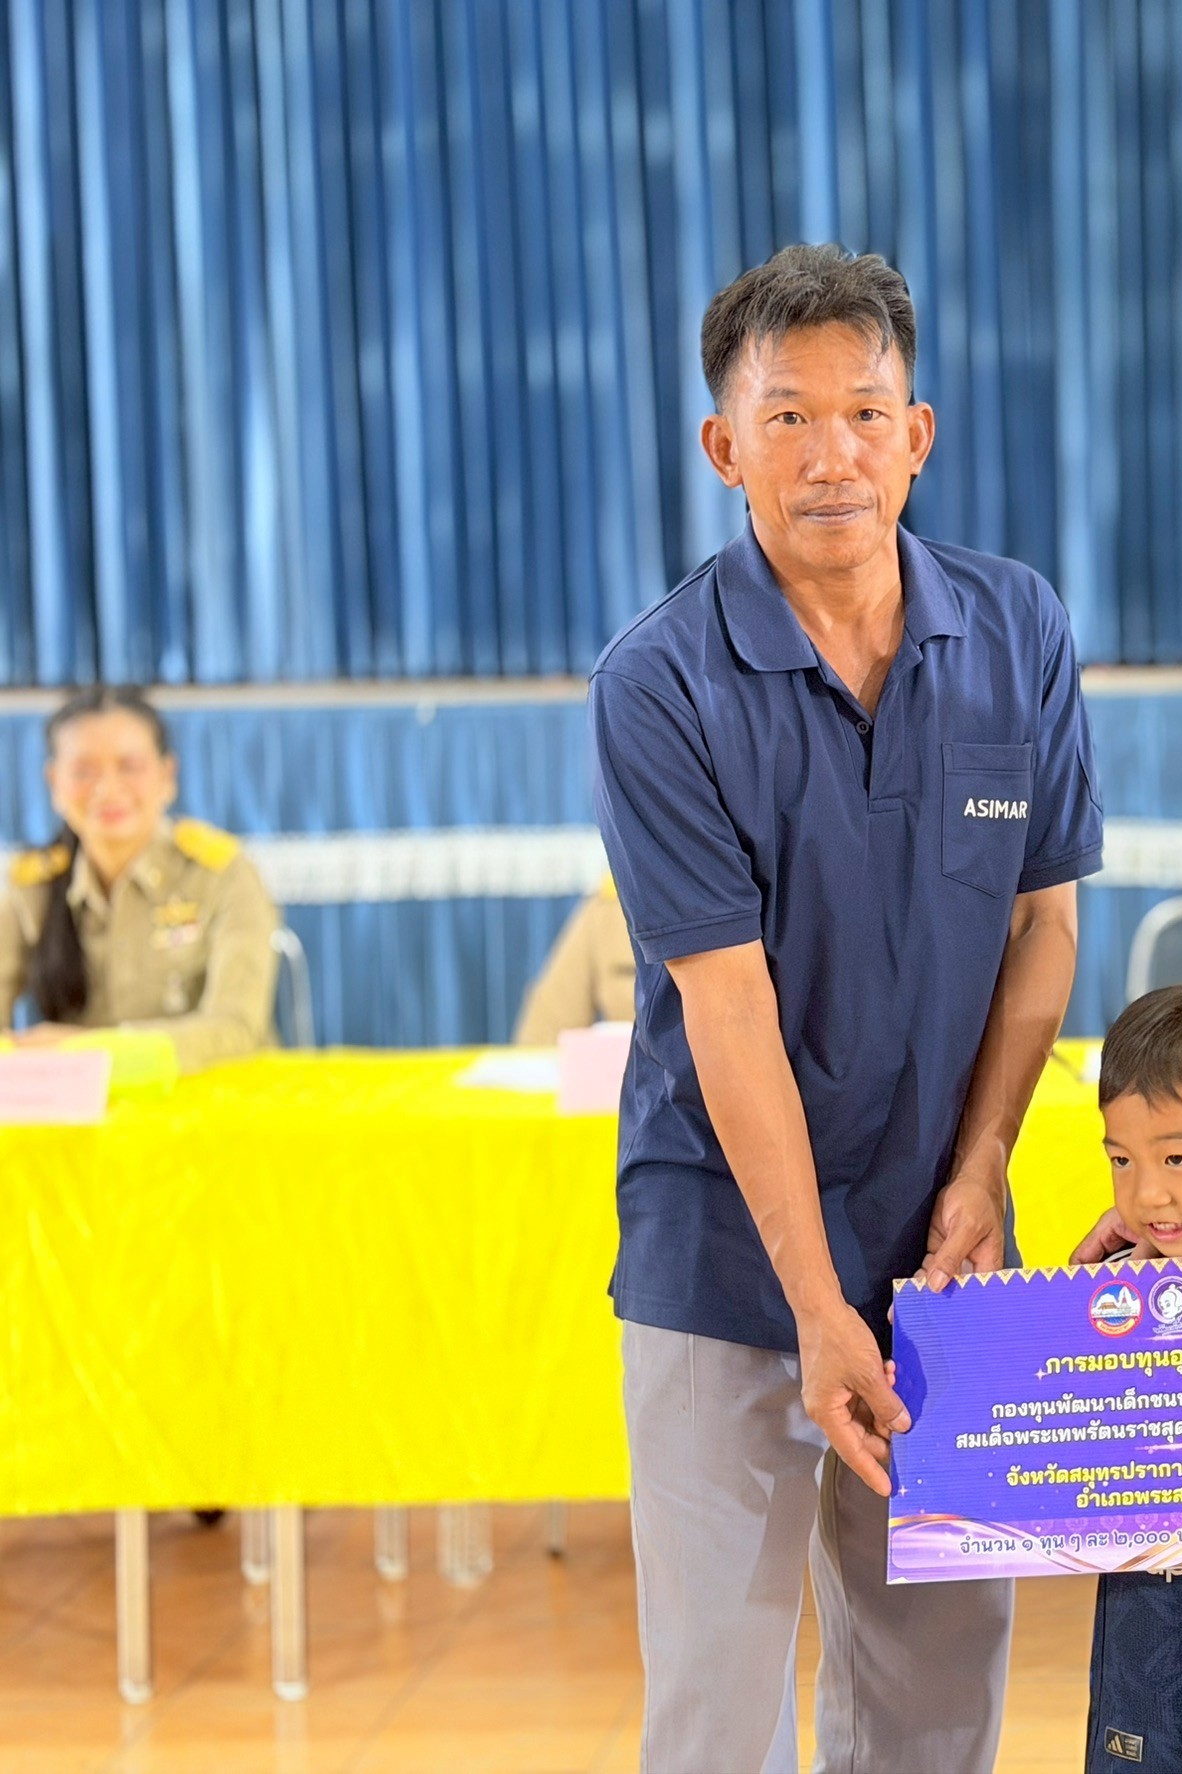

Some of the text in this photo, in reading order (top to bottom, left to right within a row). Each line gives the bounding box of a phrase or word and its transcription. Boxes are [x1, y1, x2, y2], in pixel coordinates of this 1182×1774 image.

[964, 798, 1027, 819] ASIMAR
[960, 1536, 1015, 1553] จำนวน
[1022, 1539, 1033, 1551] ๑
[1040, 1535, 1065, 1555] ทุน
[1070, 1535, 1080, 1551] ๆ
[1087, 1532, 1108, 1547] ละ
[1113, 1529, 1171, 1548] ๒,๐๐๐
